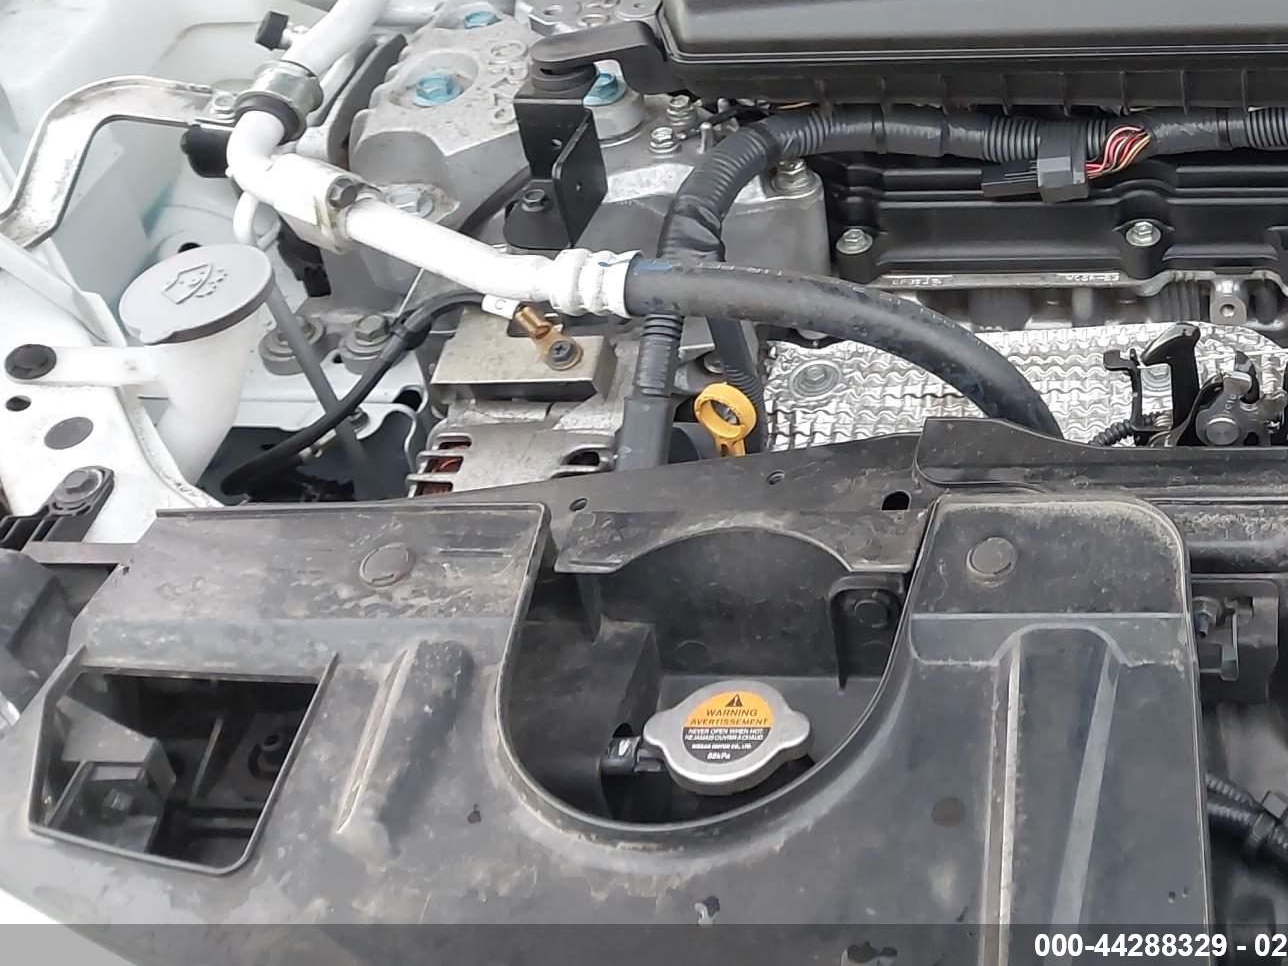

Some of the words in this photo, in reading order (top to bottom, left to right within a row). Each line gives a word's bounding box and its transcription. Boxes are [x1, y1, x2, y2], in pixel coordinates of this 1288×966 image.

[495, 299, 507, 310] C
[706, 708, 758, 717] WARNING
[689, 718, 769, 726] AVERTISSEMENT
